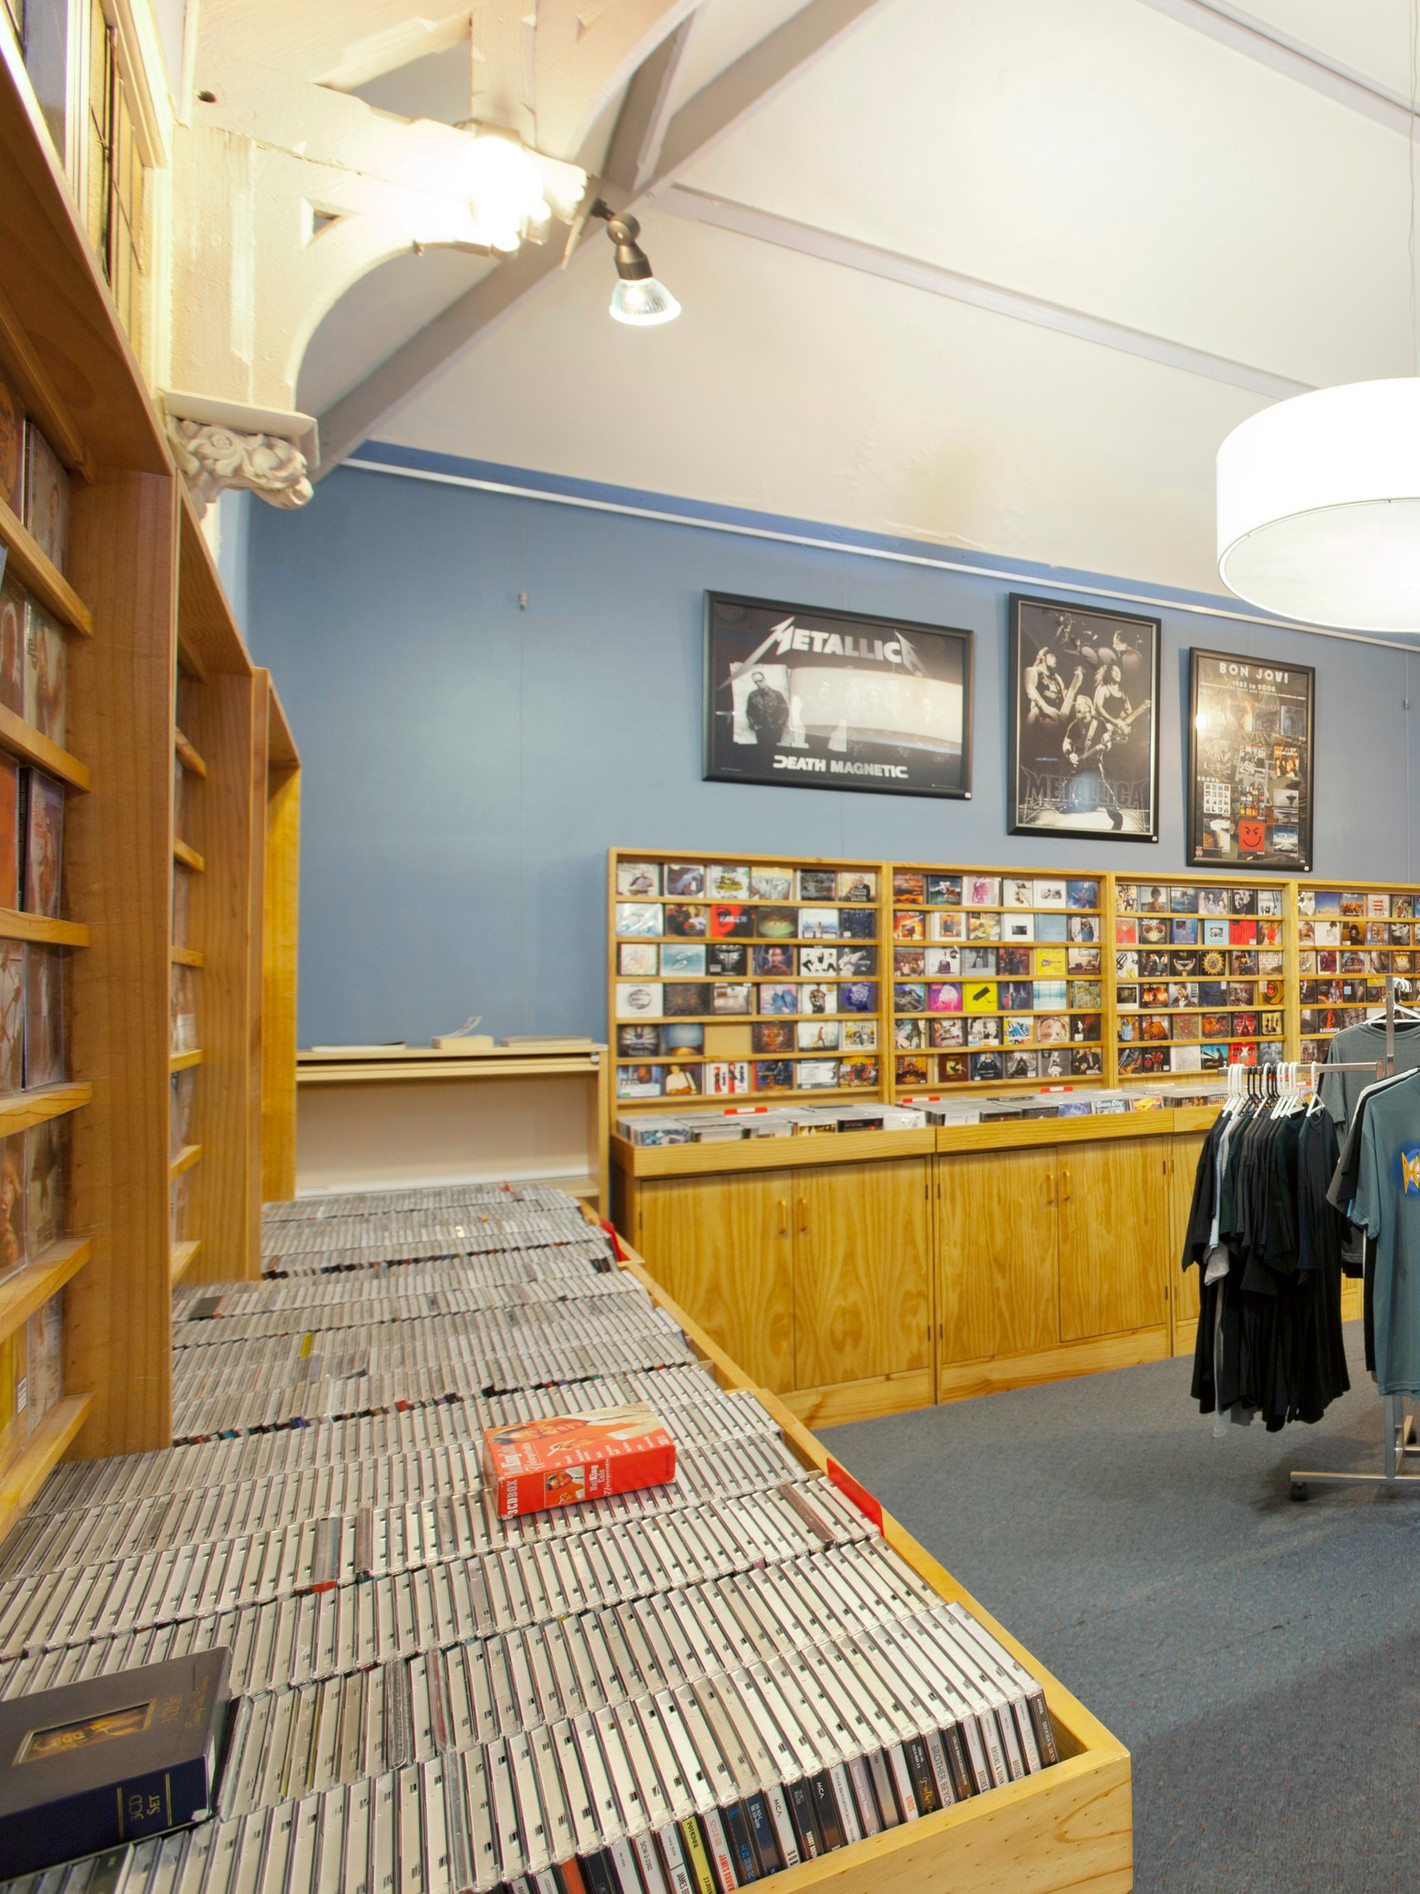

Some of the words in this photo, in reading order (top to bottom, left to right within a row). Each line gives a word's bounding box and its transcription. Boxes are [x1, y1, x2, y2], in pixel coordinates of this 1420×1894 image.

[718, 616, 928, 690] METALLICA
[1219, 662, 1249, 677] BON
[1256, 669, 1289, 684] JOVI
[773, 755, 826, 772] DEATH
[830, 760, 909, 779] MAGNETIC
[1021, 765, 1149, 832] METALLICA
[929, 1744, 947, 1781] BROTHER
[989, 1745, 1001, 1765] BROOKS
[1011, 1759, 1022, 1777] BROOKS
[976, 1770, 988, 1787] BROOKS
[815, 1781, 825, 1798] MCA
[127, 1793, 144, 1822] 3CD
[772, 1798, 782, 1817] MCA
[904, 1794, 916, 1812] BROS
[717, 1852, 730, 1872] JAMES
